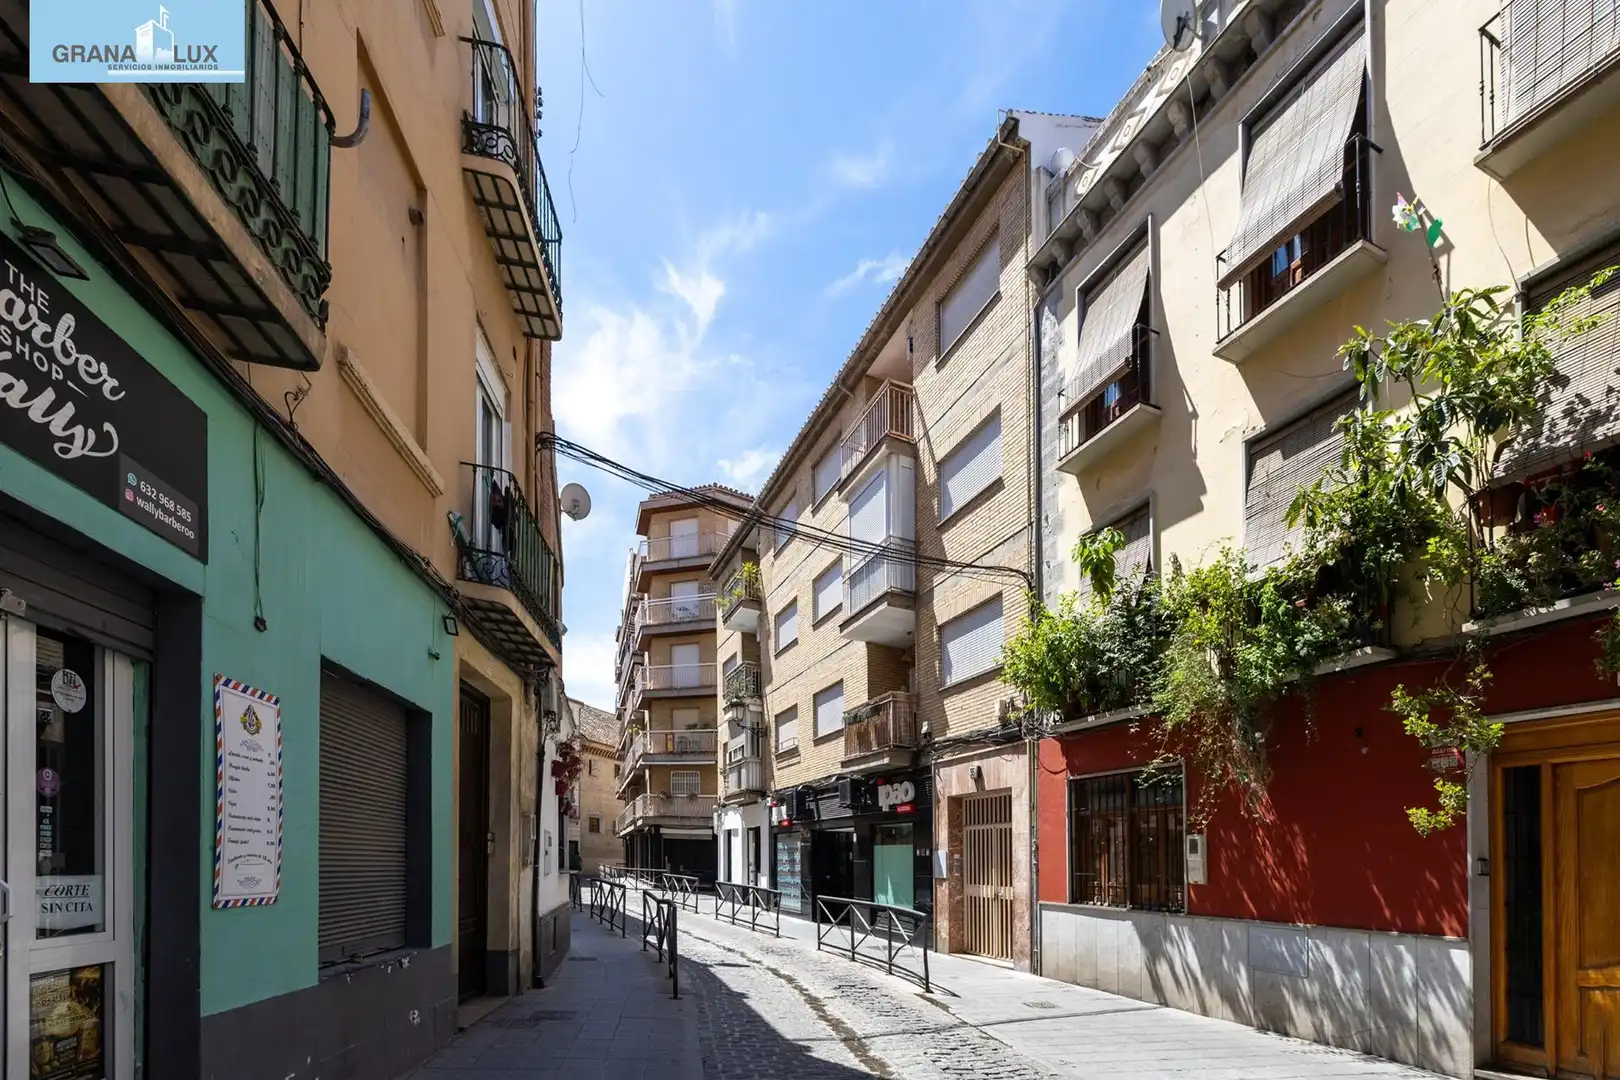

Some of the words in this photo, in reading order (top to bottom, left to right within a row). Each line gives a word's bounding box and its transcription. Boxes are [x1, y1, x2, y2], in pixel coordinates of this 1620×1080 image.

[4, 259, 50, 314] THE
[0, 288, 126, 401] arber
[0, 324, 64, 381] SHOP
[0, 351, 119, 459] ally
[136, 496, 195, 539] wallybarberoo
[140, 481, 157, 500] 632
[159, 493, 175, 512] 968
[176, 505, 192, 522] 585
[40, 902, 63, 914] SIN
[65, 901, 93, 913] CITA
[44, 884, 91, 897] CORTE
